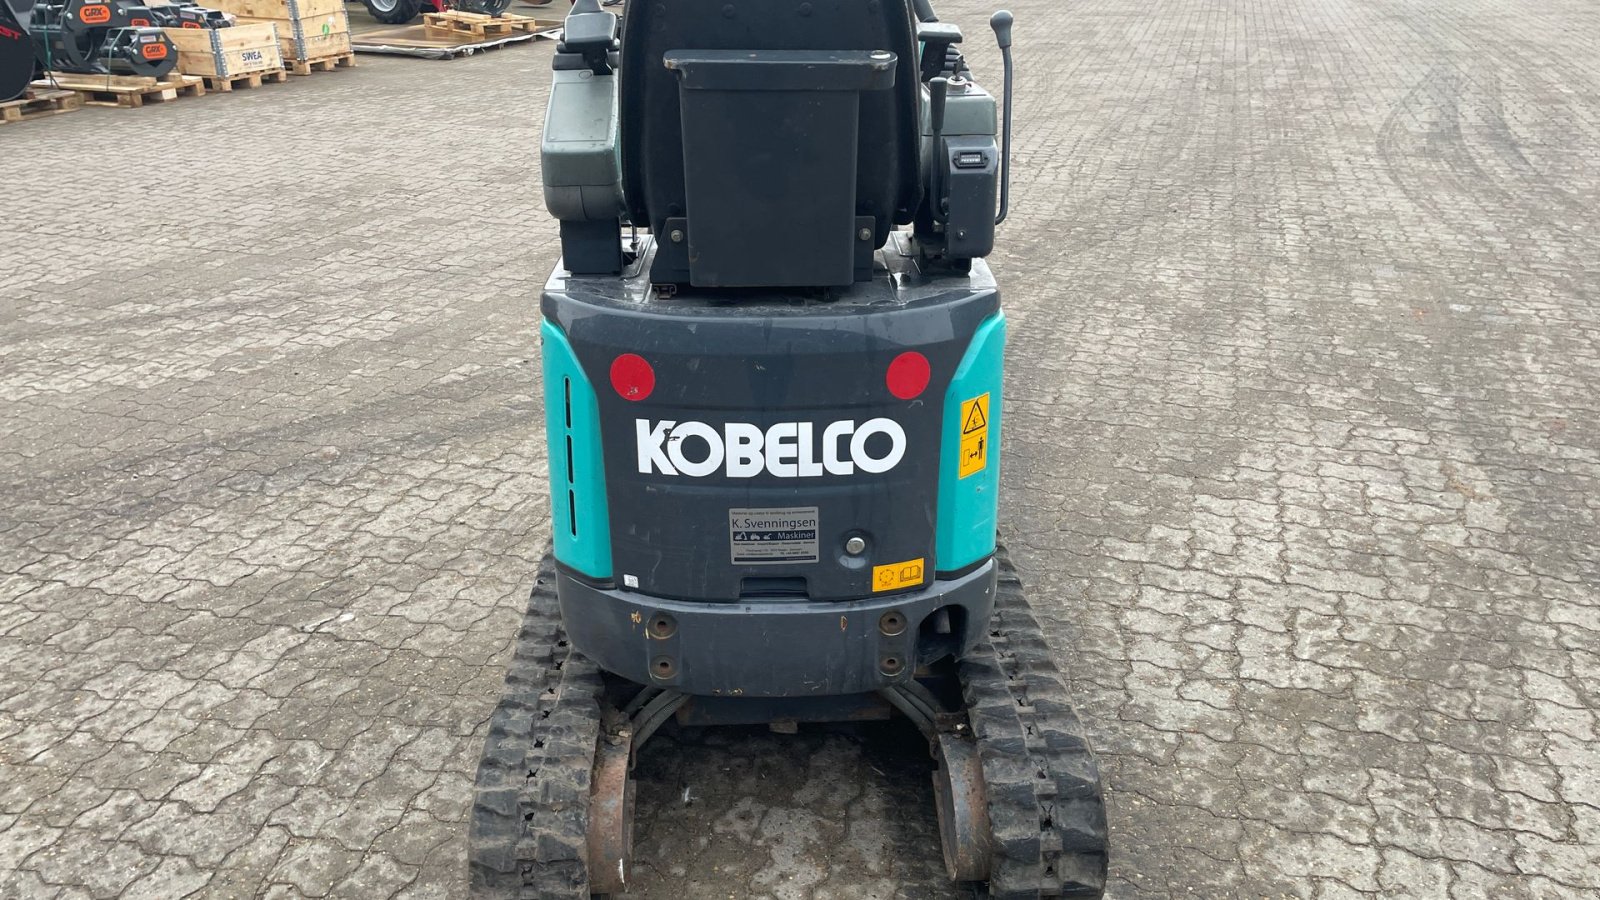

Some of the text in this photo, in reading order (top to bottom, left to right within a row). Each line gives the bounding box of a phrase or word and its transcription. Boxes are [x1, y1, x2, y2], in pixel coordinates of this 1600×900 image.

[241, 51, 262, 61] SWEA
[635, 417, 907, 477] KOBELCO
[732, 518, 816, 529] K. Svenningsen
[777, 531, 815, 540] Maskiner
